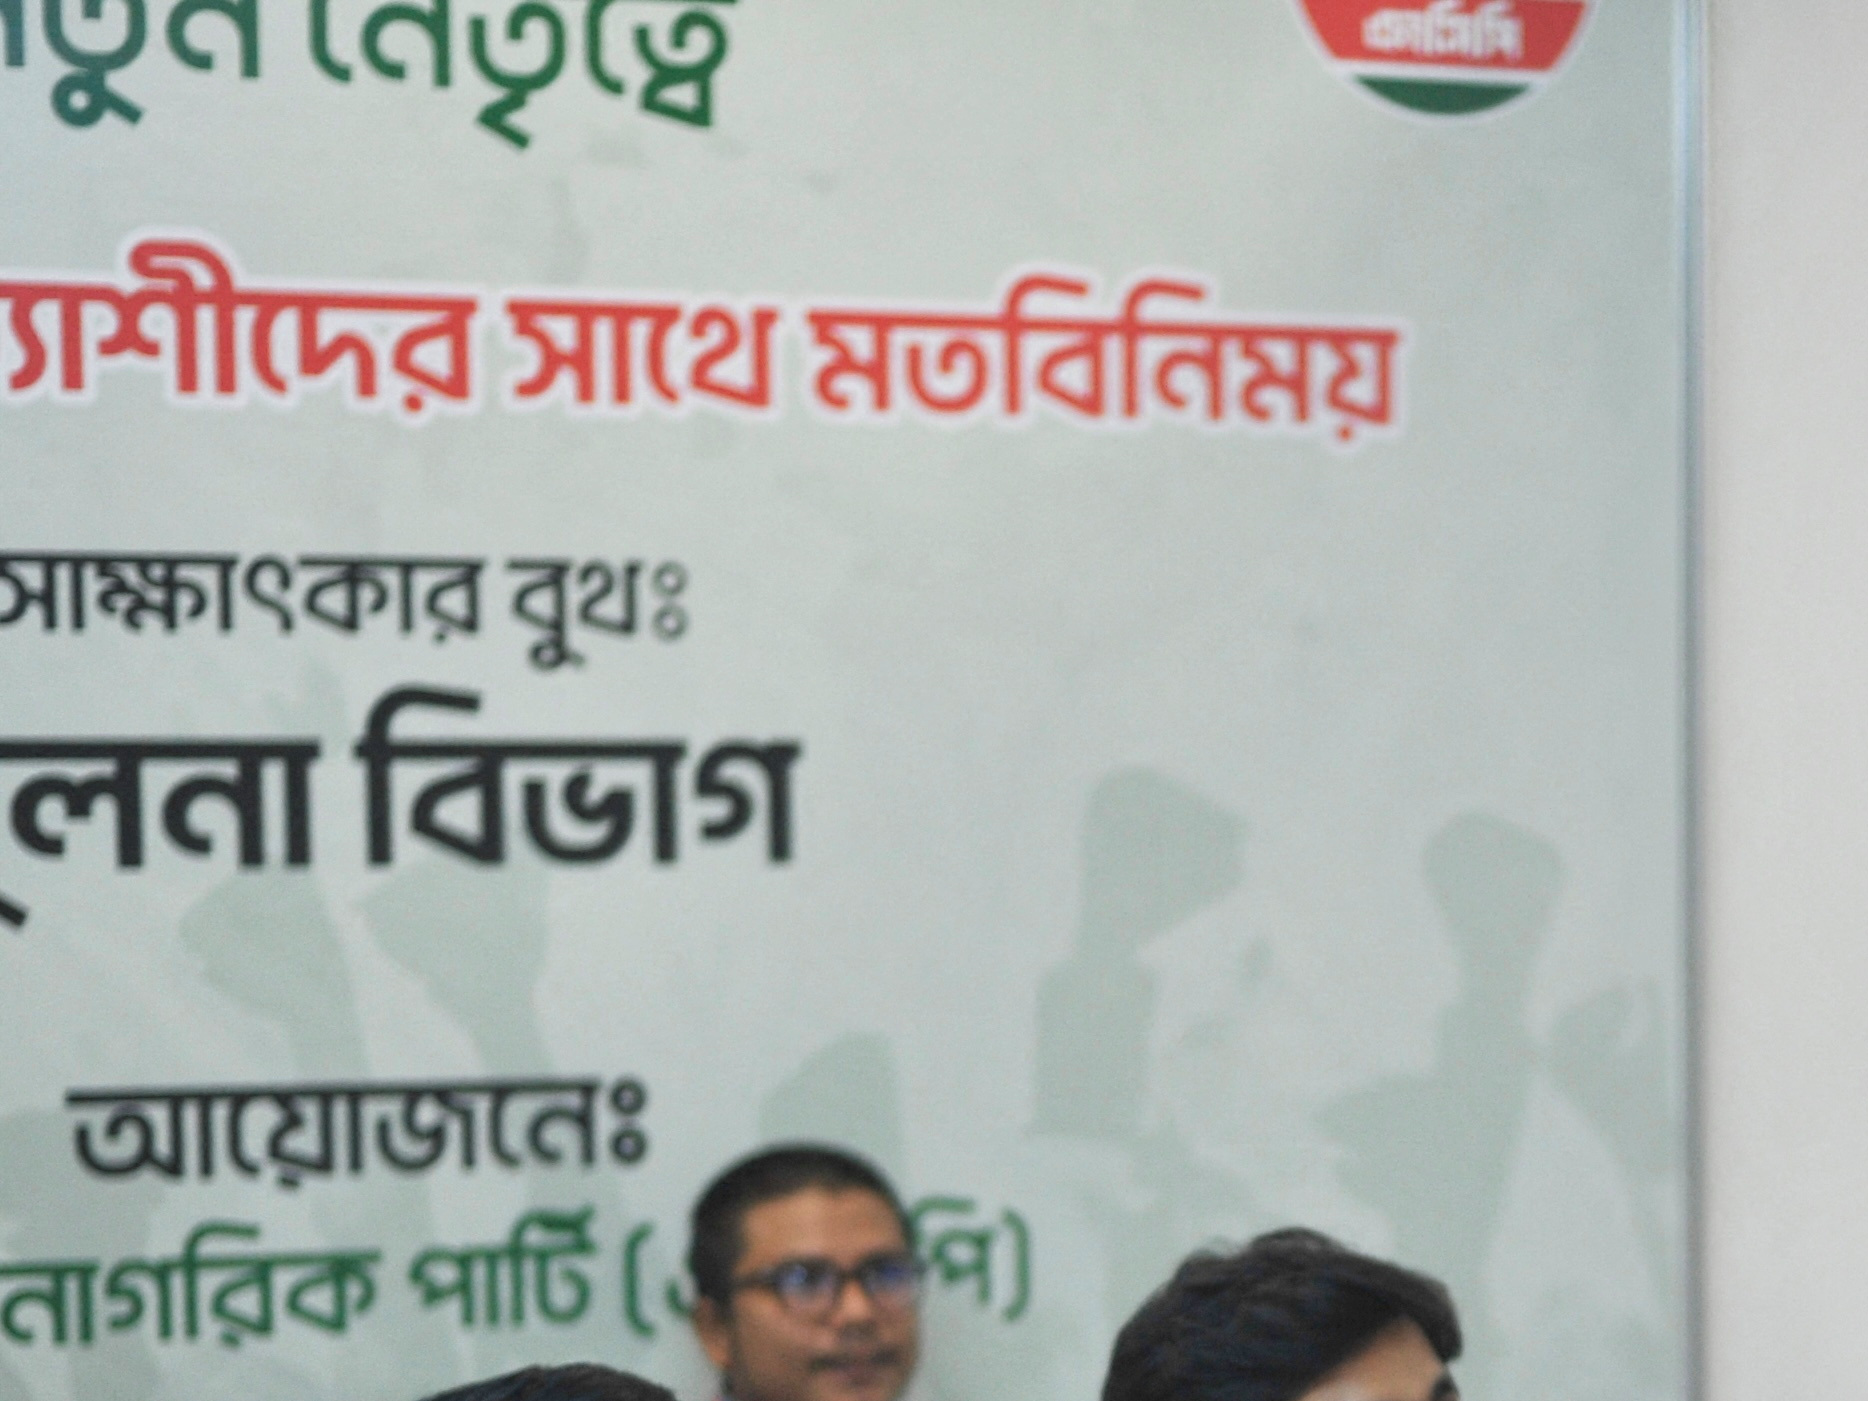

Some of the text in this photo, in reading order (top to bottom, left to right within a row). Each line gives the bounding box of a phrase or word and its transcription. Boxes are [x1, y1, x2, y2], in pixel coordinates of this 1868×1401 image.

[507, 300, 780, 409] সাথে
[807, 273, 1400, 442] মতবিনিময়
[355, 686, 803, 866] বিভাগ
[66, 1077, 648, 1190] আয়োজনেঃ
[0, 1220, 382, 1347] নাগরিক
[410, 1206, 599, 1330] পার্টি
